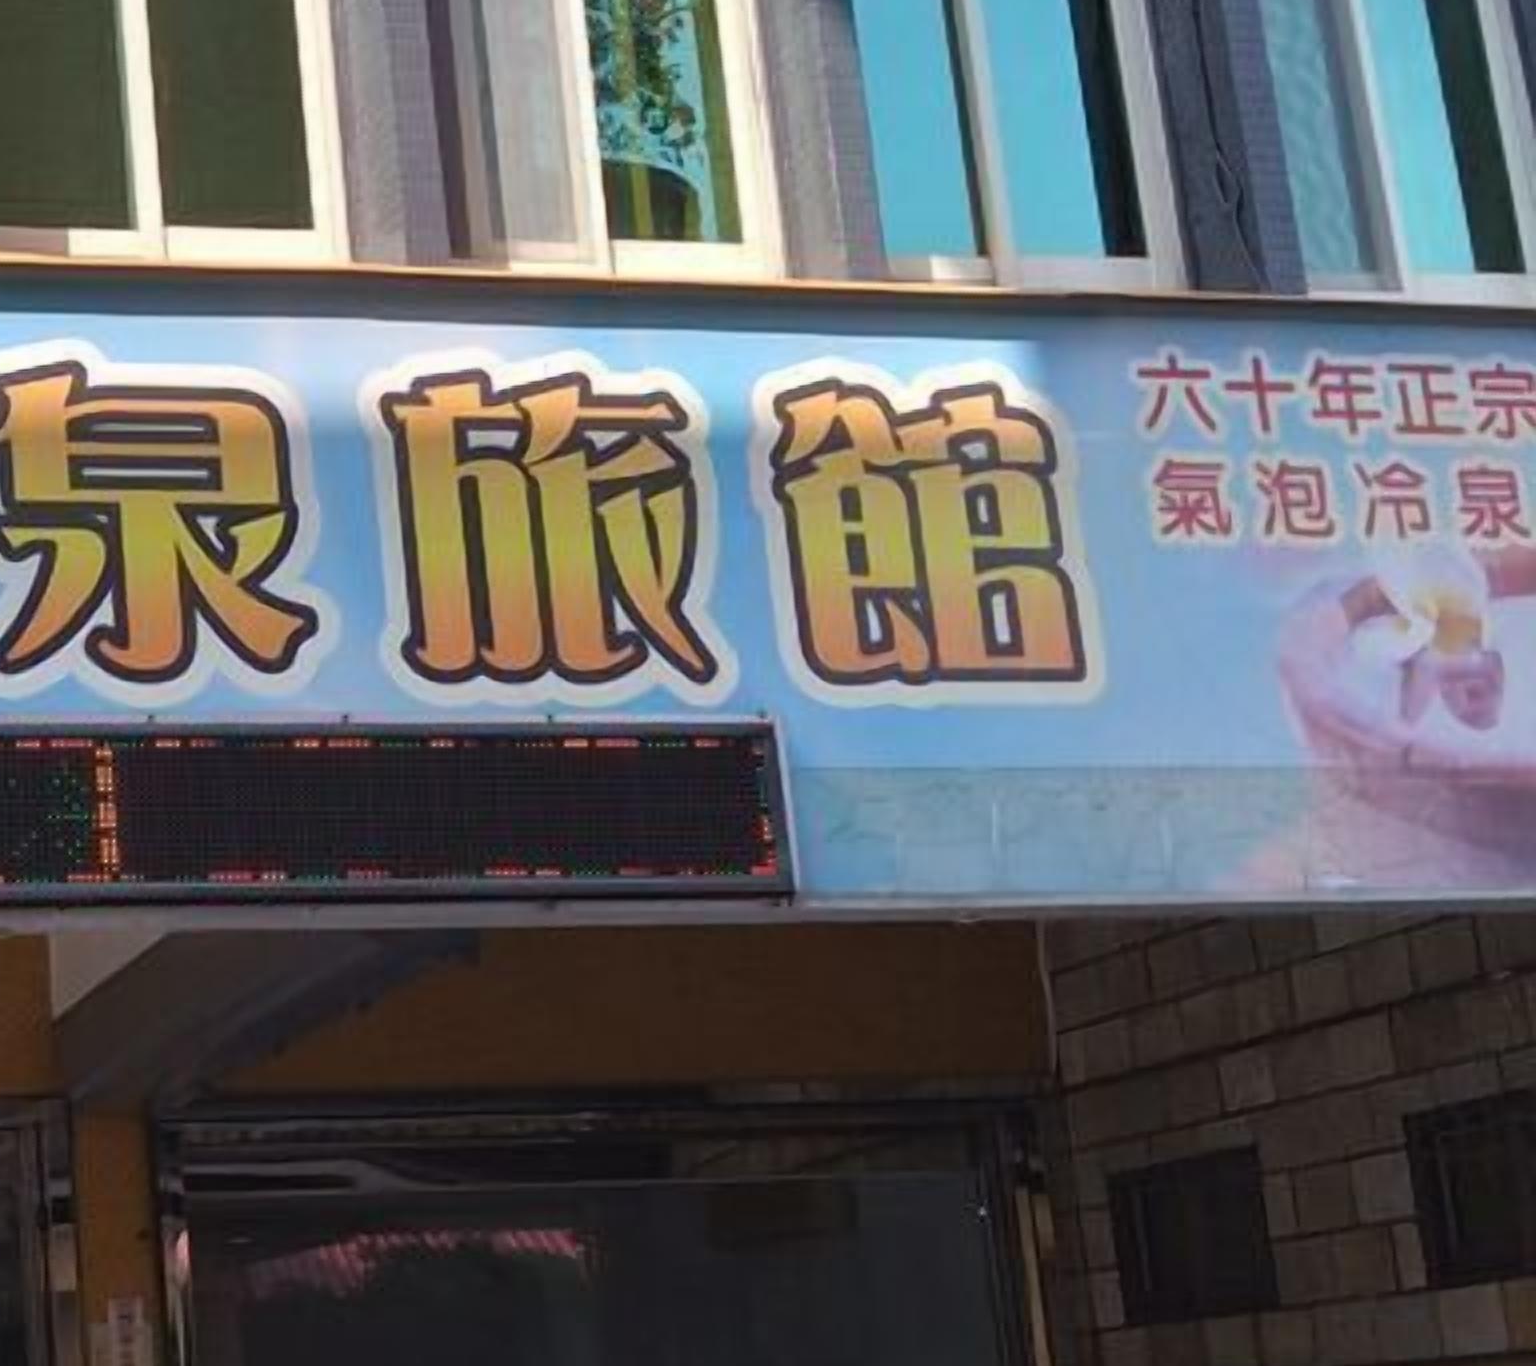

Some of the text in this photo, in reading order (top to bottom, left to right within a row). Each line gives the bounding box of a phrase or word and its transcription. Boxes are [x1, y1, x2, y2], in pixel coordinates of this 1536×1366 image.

[1136, 353, 1536, 439] 六十年正宗
[1153, 457, 1532, 540] 氣泡冷泉
